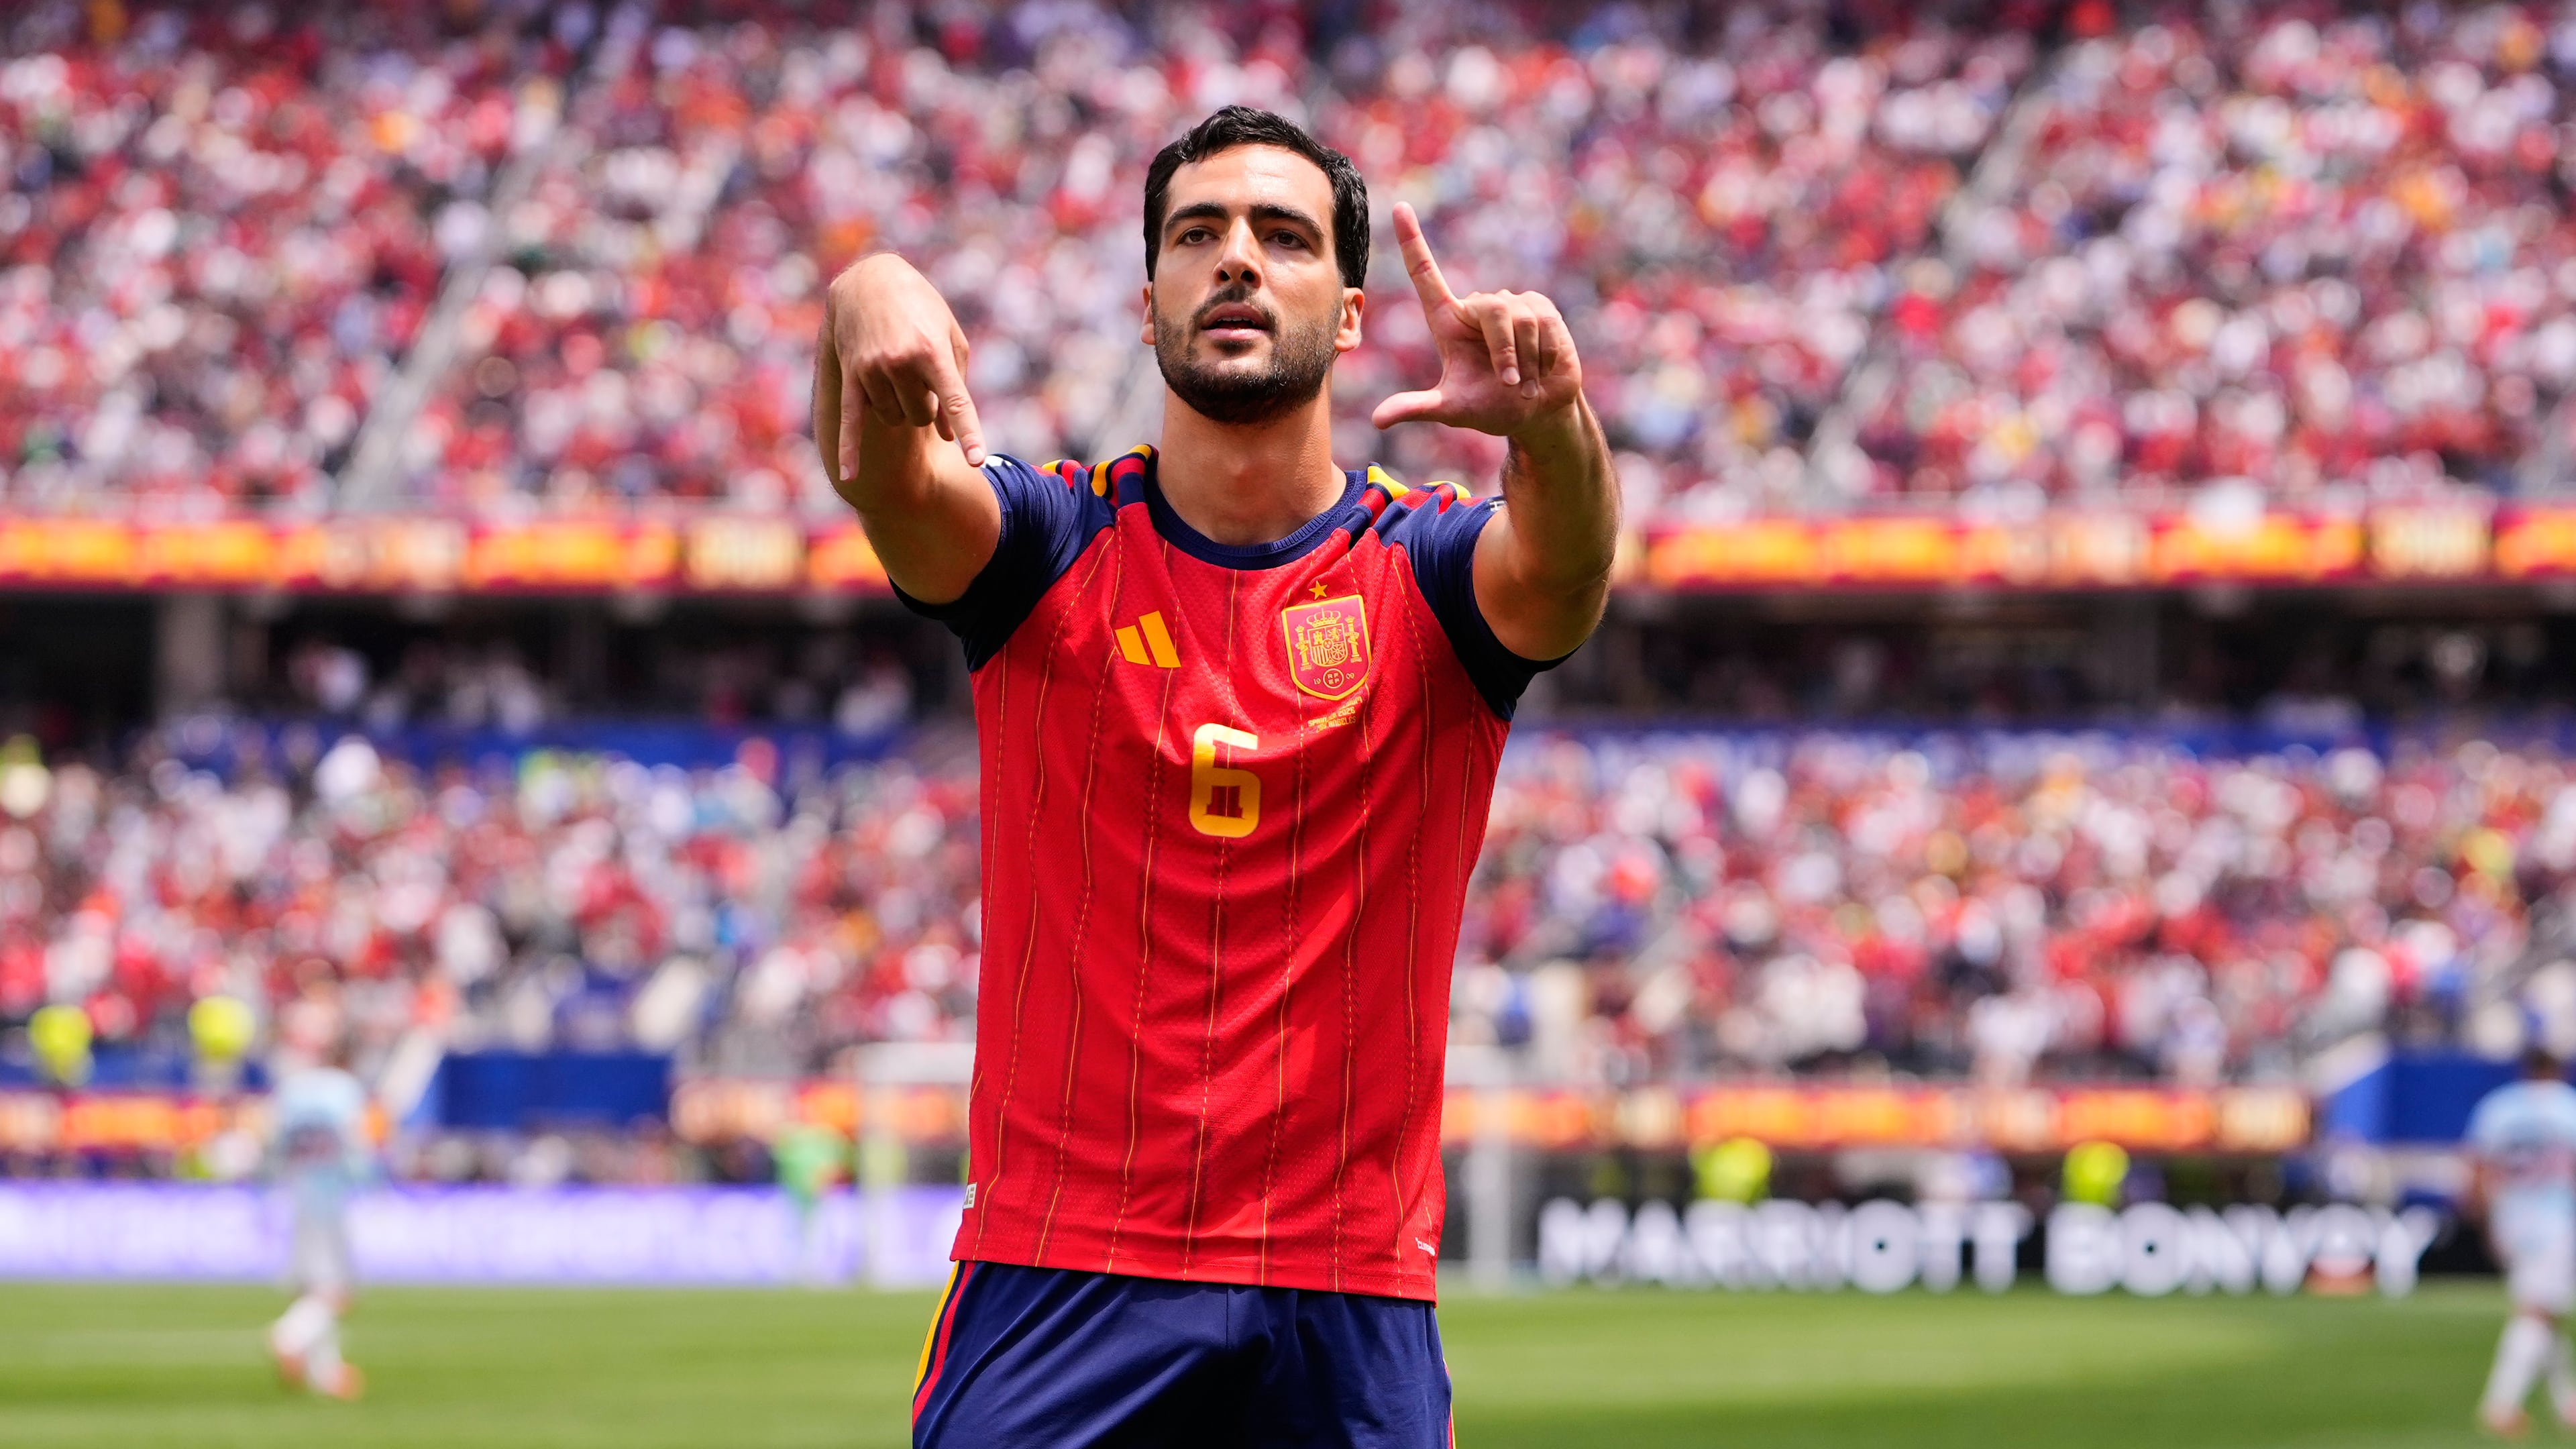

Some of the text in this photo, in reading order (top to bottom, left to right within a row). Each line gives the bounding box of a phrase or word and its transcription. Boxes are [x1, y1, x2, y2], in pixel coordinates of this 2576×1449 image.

[1189, 722, 1261, 838] 6
[1538, 1197, 2437, 1298] MARRIOTT BONVOY
